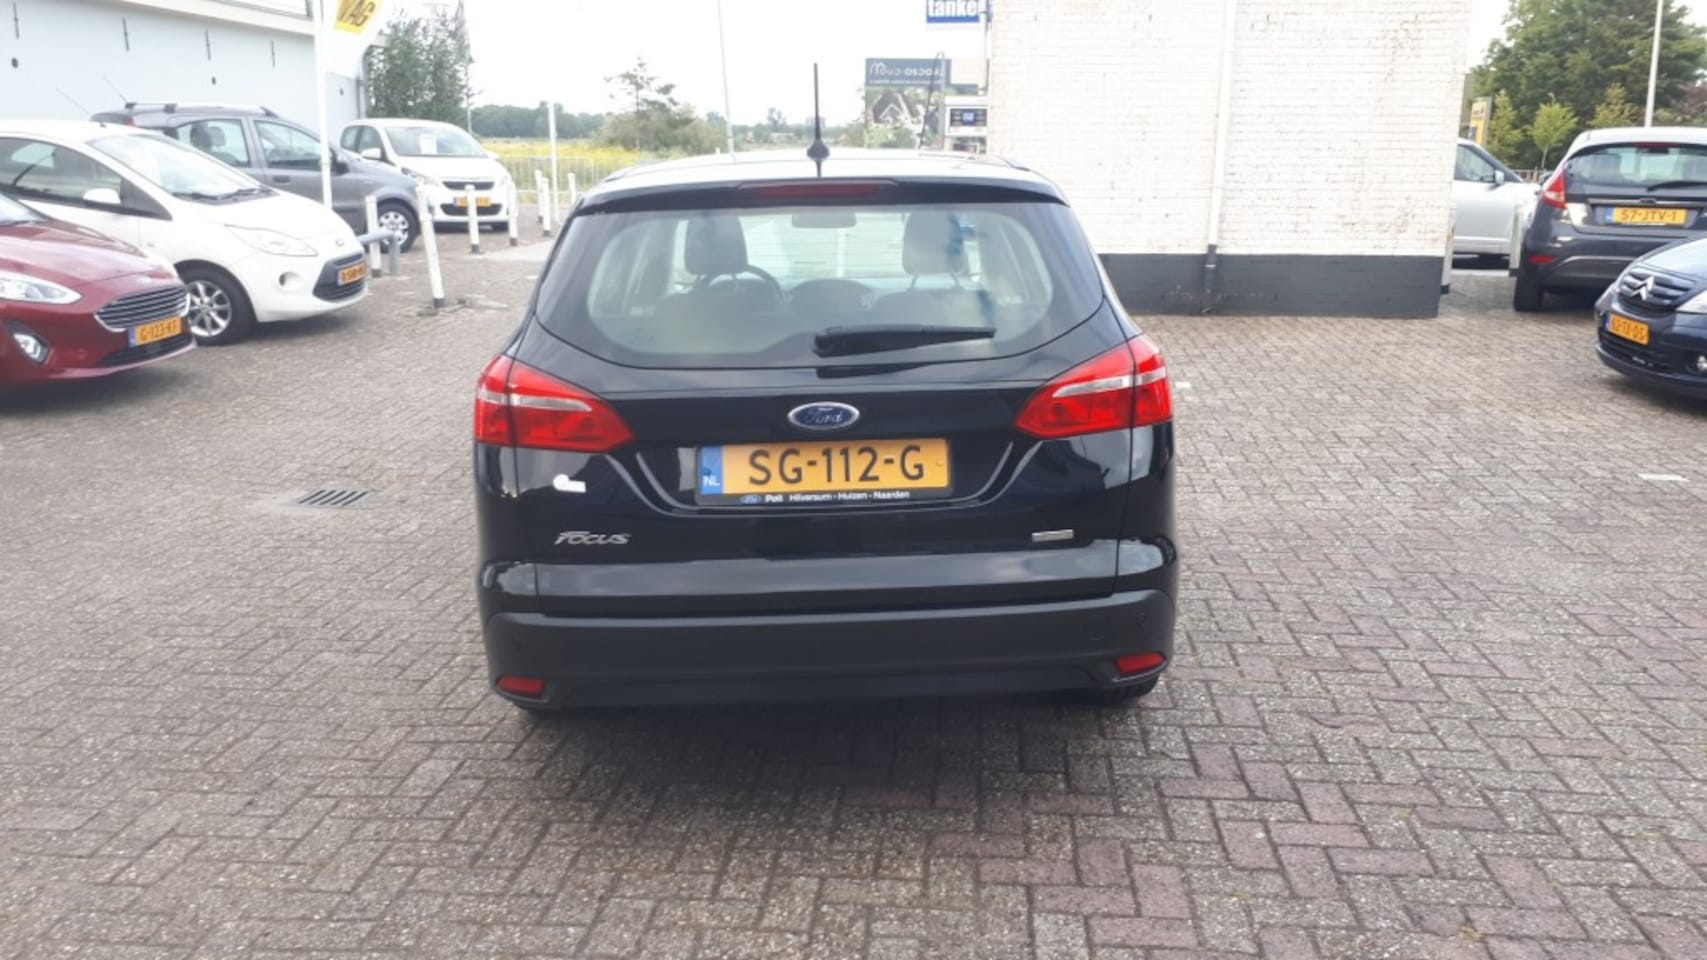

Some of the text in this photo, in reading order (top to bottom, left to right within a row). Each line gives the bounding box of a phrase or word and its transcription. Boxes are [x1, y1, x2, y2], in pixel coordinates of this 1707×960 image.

[1620, 208, 1678, 221] 57-JTV-1
[703, 444, 925, 487] NL SG-112-G
